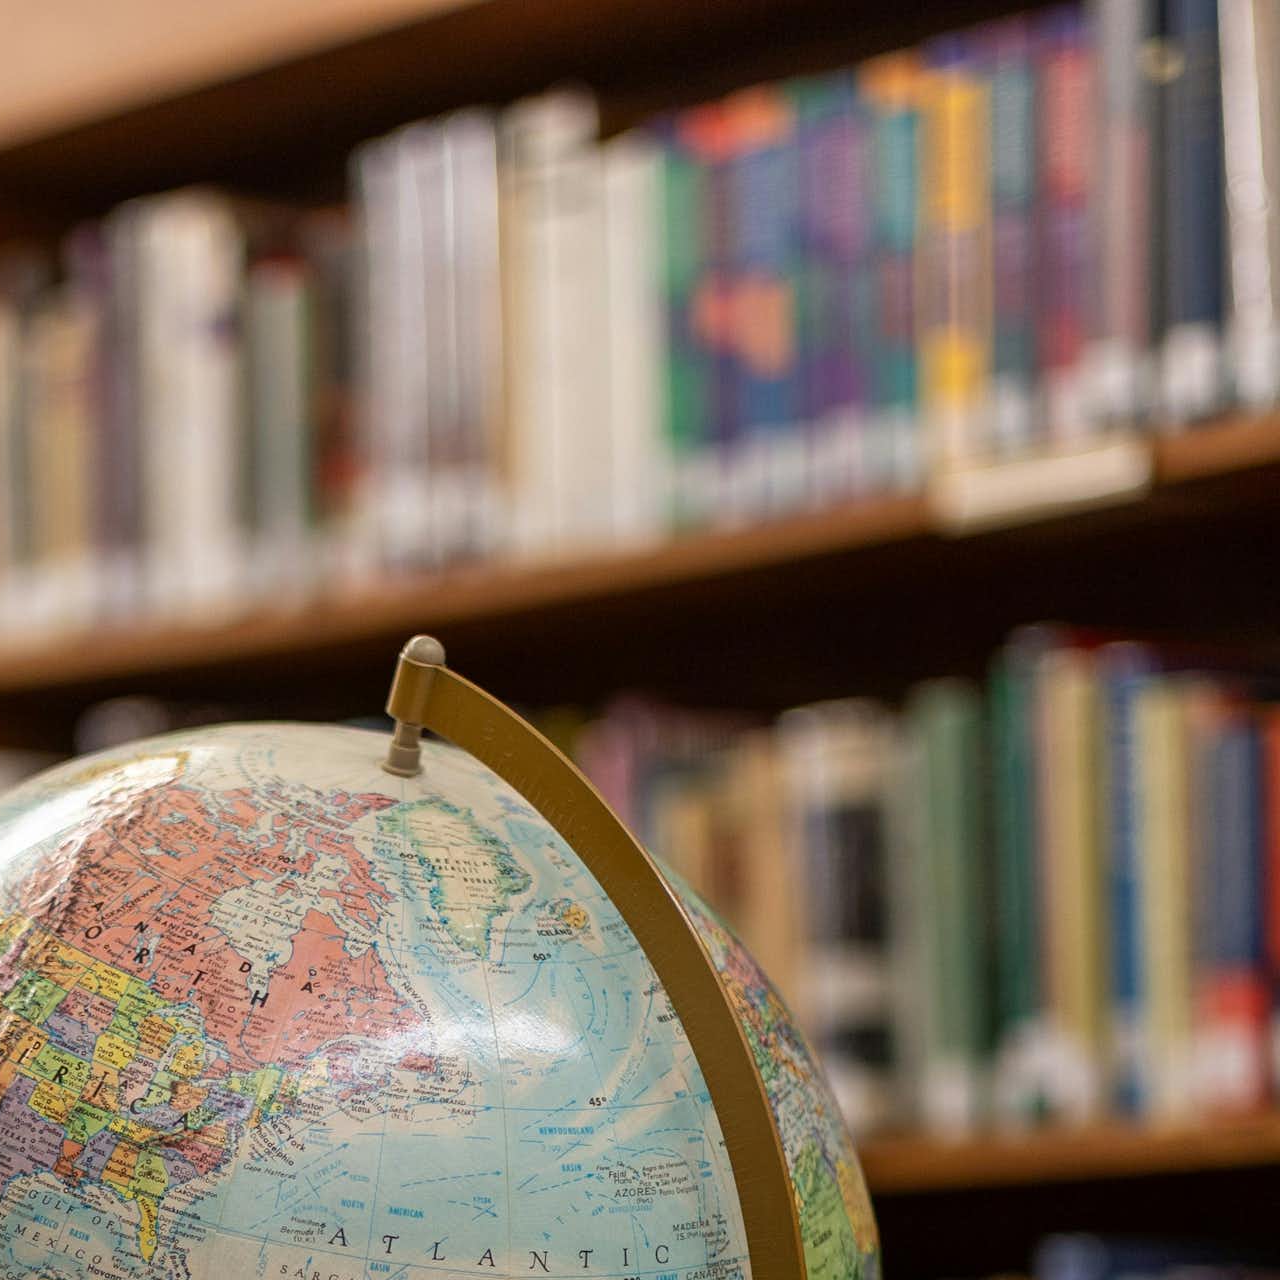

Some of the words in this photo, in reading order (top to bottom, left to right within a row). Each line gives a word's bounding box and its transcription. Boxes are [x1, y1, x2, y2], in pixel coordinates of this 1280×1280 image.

[234, 897, 292, 920] HUDSON
[589, 1096, 607, 1107] 45°
[614, 1186, 657, 1198] AZORES
[29, 1189, 74, 1215] GULF
[387, 1206, 424, 1219] AMERICAN
[672, 1219, 710, 1232] MADEIRA
[16, 1223, 103, 1266] MEXICO
[328, 1226, 670, 1272] ATLANTIC
